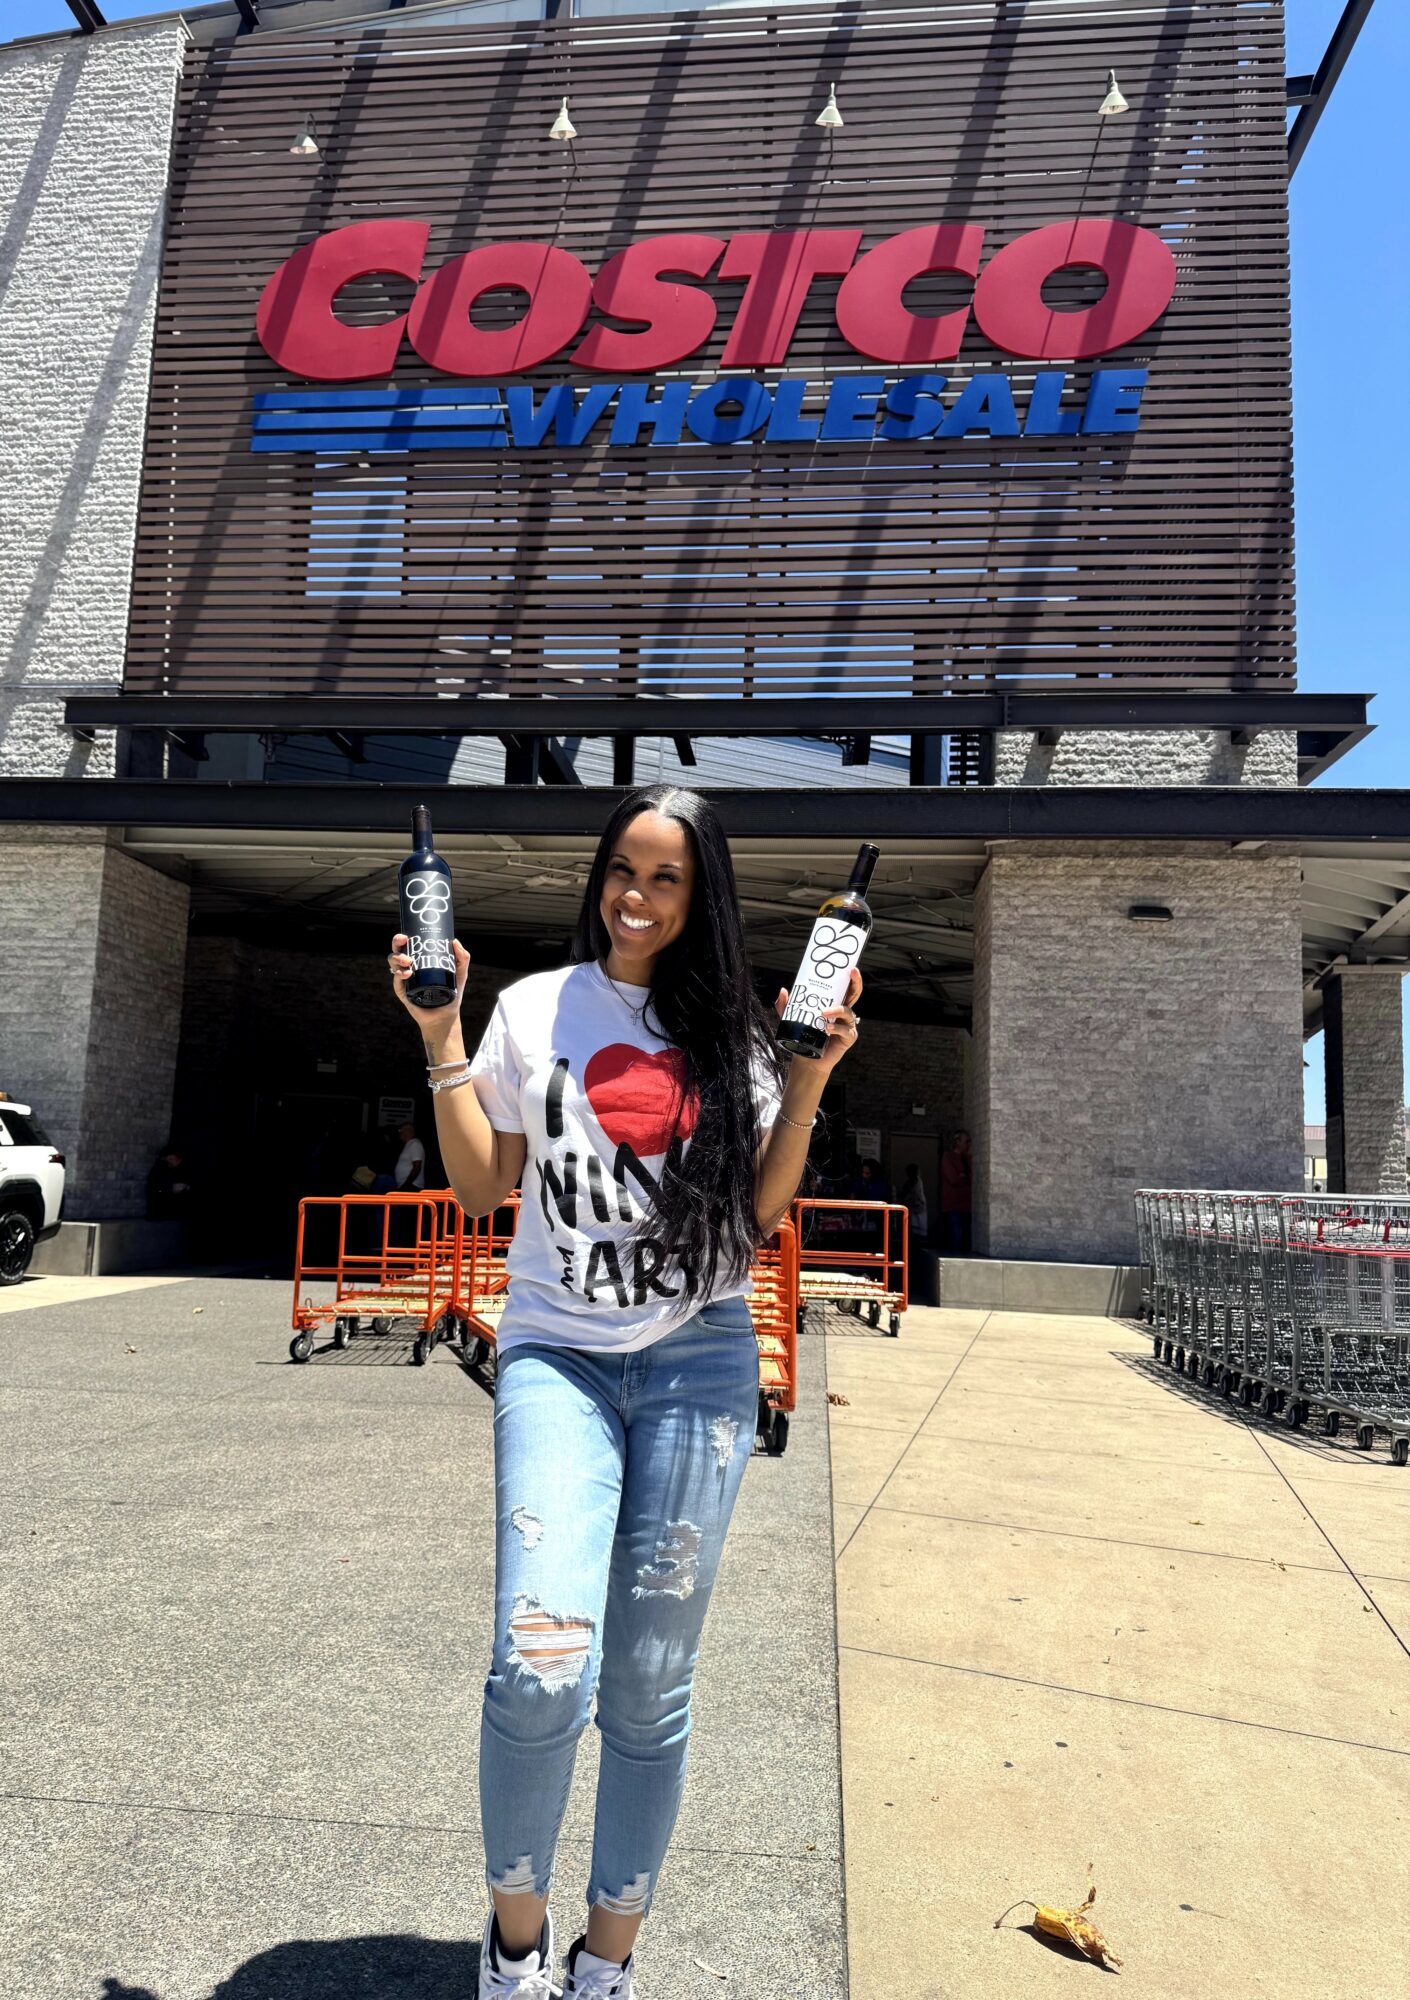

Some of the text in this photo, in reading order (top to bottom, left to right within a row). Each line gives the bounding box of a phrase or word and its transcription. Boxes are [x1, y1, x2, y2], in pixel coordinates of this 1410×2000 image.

[256, 218, 1177, 381] COSTCO
[503, 368, 1149, 448] WHOLESALE
[407, 935, 450, 956] Best
[546, 1058, 570, 1139] I
